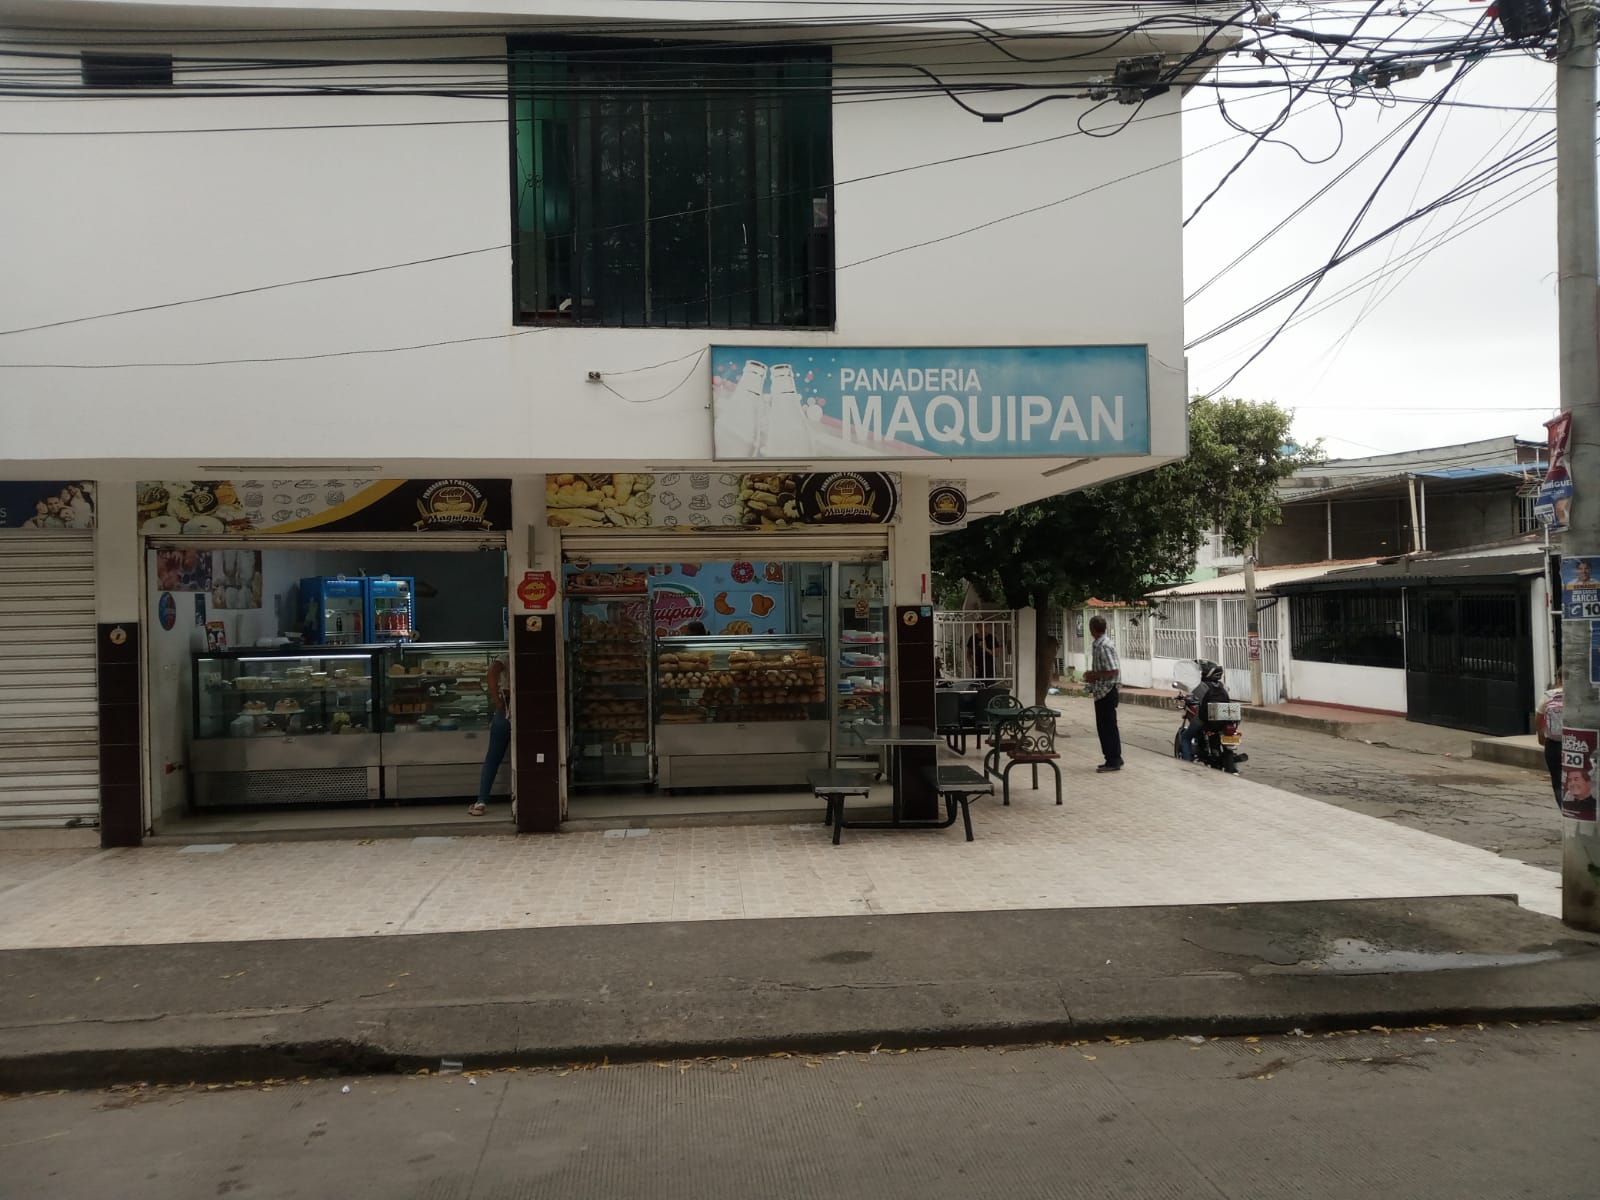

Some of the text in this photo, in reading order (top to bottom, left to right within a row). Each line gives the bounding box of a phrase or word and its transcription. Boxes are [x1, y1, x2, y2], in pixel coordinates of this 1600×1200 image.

[840, 367, 982, 392] PANADERIA
[841, 394, 1124, 446] MAQUIPAN
[1566, 754, 1582, 766] 20
